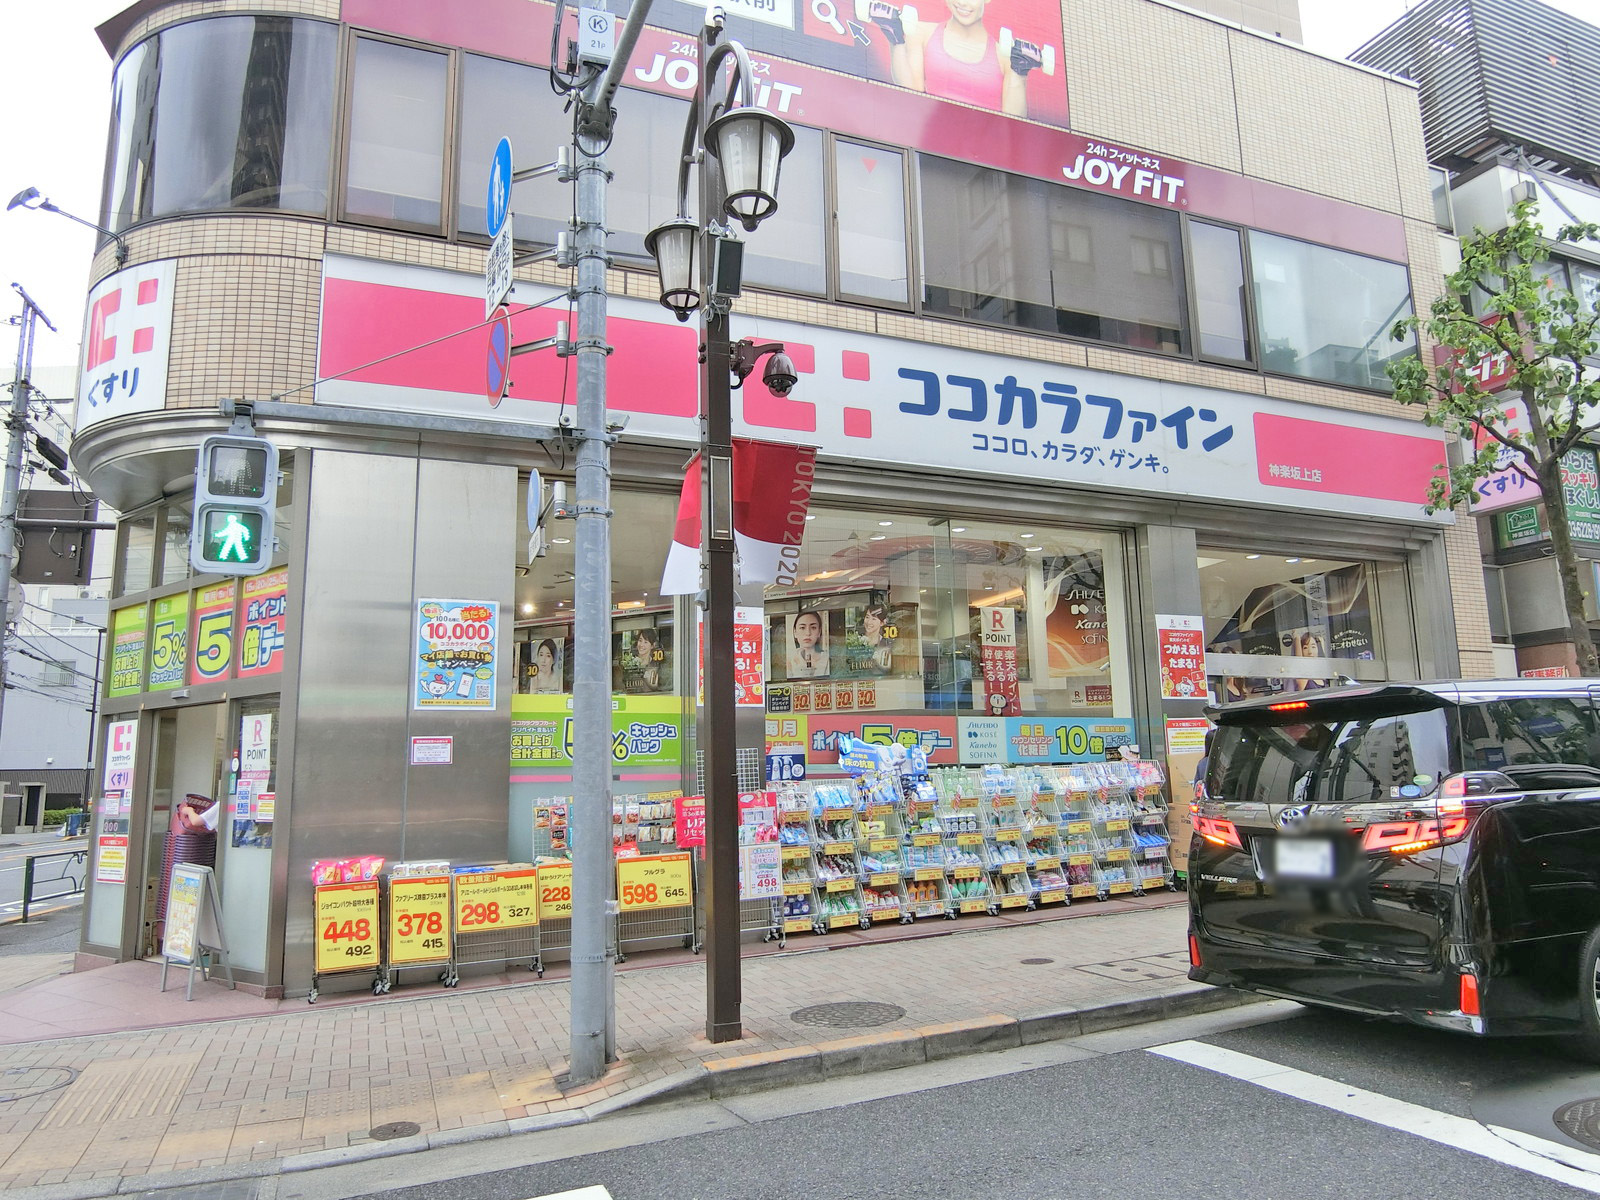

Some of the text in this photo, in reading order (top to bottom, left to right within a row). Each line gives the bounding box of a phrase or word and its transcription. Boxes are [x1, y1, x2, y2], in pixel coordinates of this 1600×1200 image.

[669, 41, 698, 58] 24h
[1086, 142, 1161, 171] 24h フィットネス
[1062, 154, 1132, 190] JOY
[87, 366, 140, 408] くすり
[898, 367, 1234, 452] ココカラファイン
[972, 433, 1170, 475] ココロ、カラダ、ゲンキ。
[1268, 462, 1323, 484] 神楽坂上店
[1560, 469, 1598, 490] スッキリ
[787, 449, 817, 526] TOKYO
[1478, 472, 1526, 496] くすり
[775, 530, 802, 588] 2020
[427, 622, 490, 641] 10,000
[883, 626, 898, 639] 10
[985, 633, 1011, 643] POINT
[195, 609, 233, 678] 5
[1163, 644, 1200, 655] つかえる!
[436, 659, 483, 669] キャンペーン
[851, 659, 874, 671] ELIXIR
[984, 649, 996, 692] 貯まる!
[994, 649, 1006, 693] 使える!
[1169, 658, 1197, 669] たまる!
[1004, 649, 1018, 714] 楽天ポイント
[630, 723, 678, 738] キャッシュ
[966, 721, 999, 729] SHISEIDO
[1020, 724, 1045, 736] 毎日
[511, 735, 552, 747] お買上げ
[969, 741, 997, 749] Kanebo
[1011, 736, 1054, 744] カウンセリング
[246, 748, 267, 761] POINT
[969, 751, 998, 759] SOFINA
[1017, 743, 1049, 756] 化粧品
[110, 770, 129, 787] くすり
[459, 874, 497, 885] 数量限定!!
[643, 868, 666, 876] フルグラ
[1200, 873, 1239, 884] VELLFIRE
[757, 878, 777, 888] 498
[541, 885, 571, 903] 228
[623, 882, 658, 905] 598
[665, 888, 685, 898] 645
